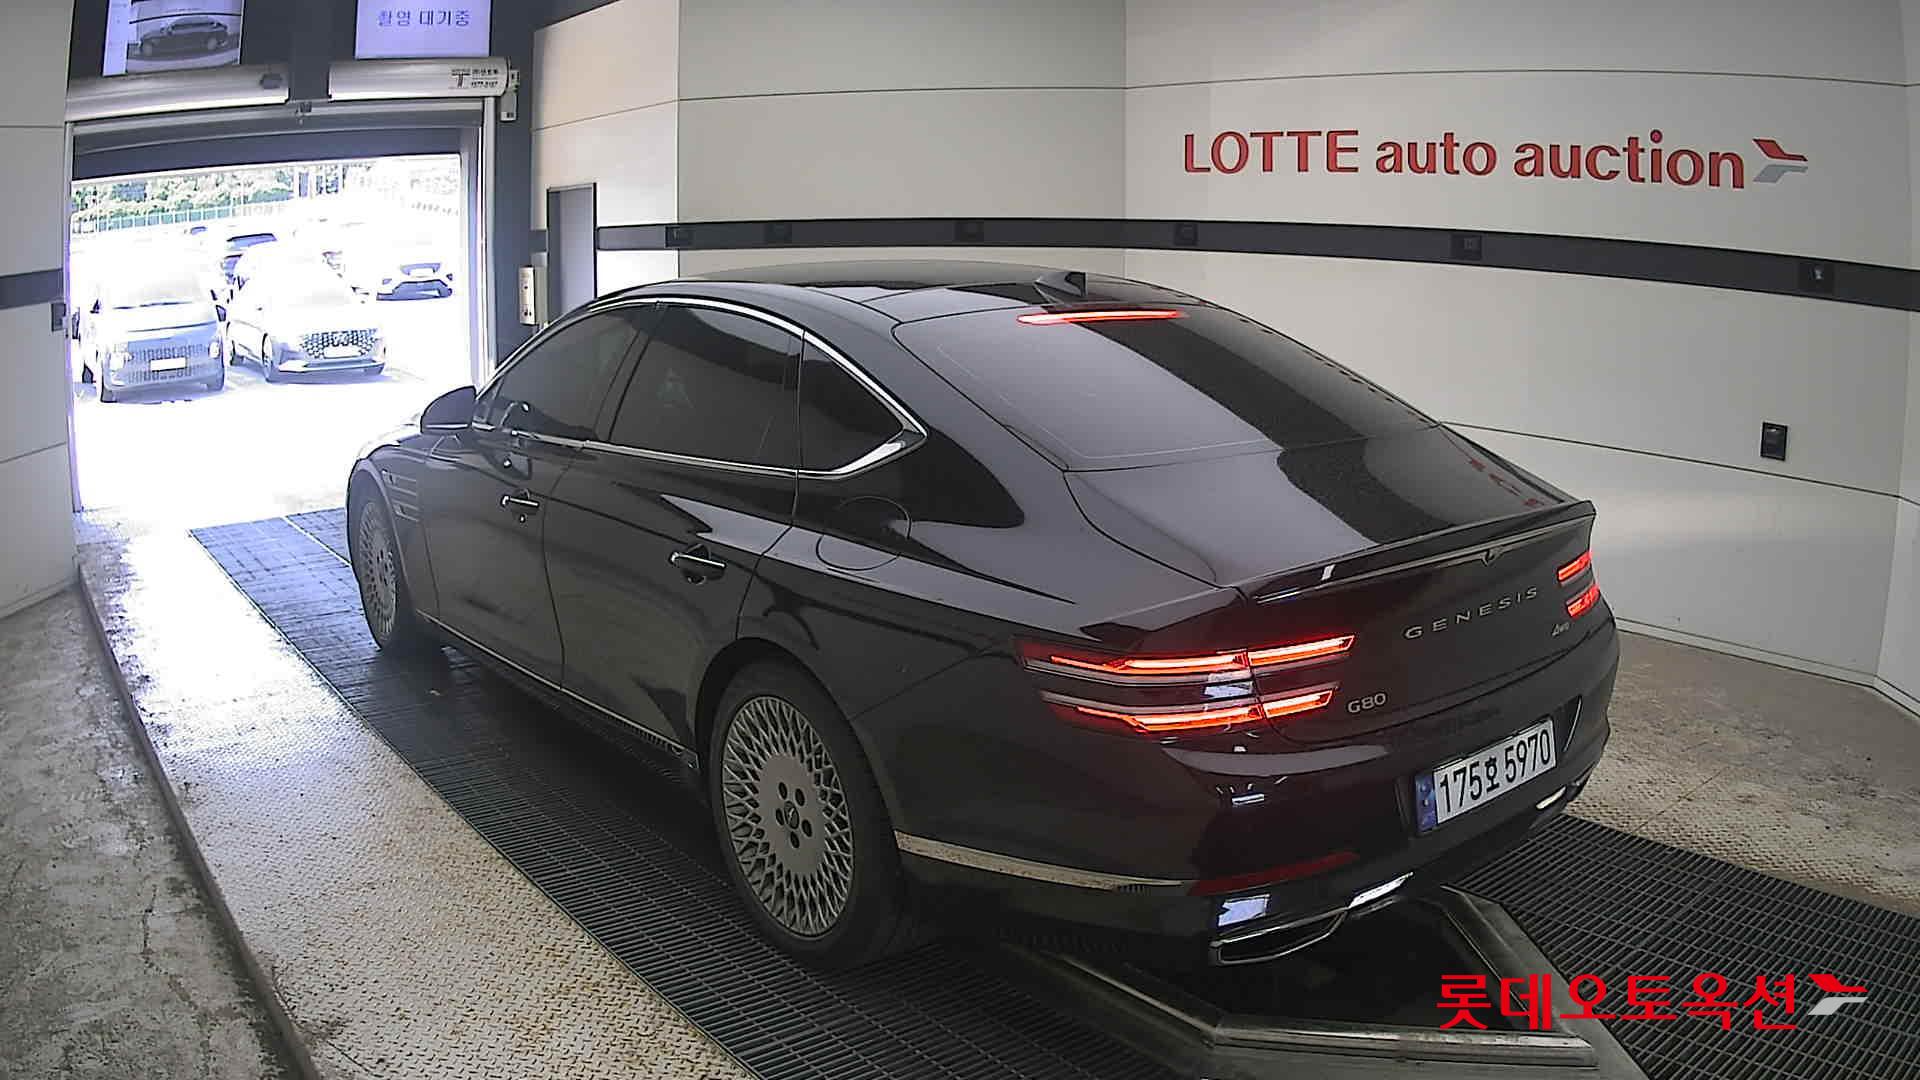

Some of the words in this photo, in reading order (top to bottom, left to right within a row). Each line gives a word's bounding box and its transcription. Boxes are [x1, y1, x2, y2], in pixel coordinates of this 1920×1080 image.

[419, 9, 470, 27] 대기중
[1184, 130, 1359, 174] LOTTE
[1376, 132, 1497, 177] auto
[1514, 129, 1744, 189] auction
[1404, 586, 1538, 640] GENESIS
[1347, 692, 1387, 714] G80
[1439, 756, 1500, 813] 175호
[1504, 728, 1551, 783] 5970
